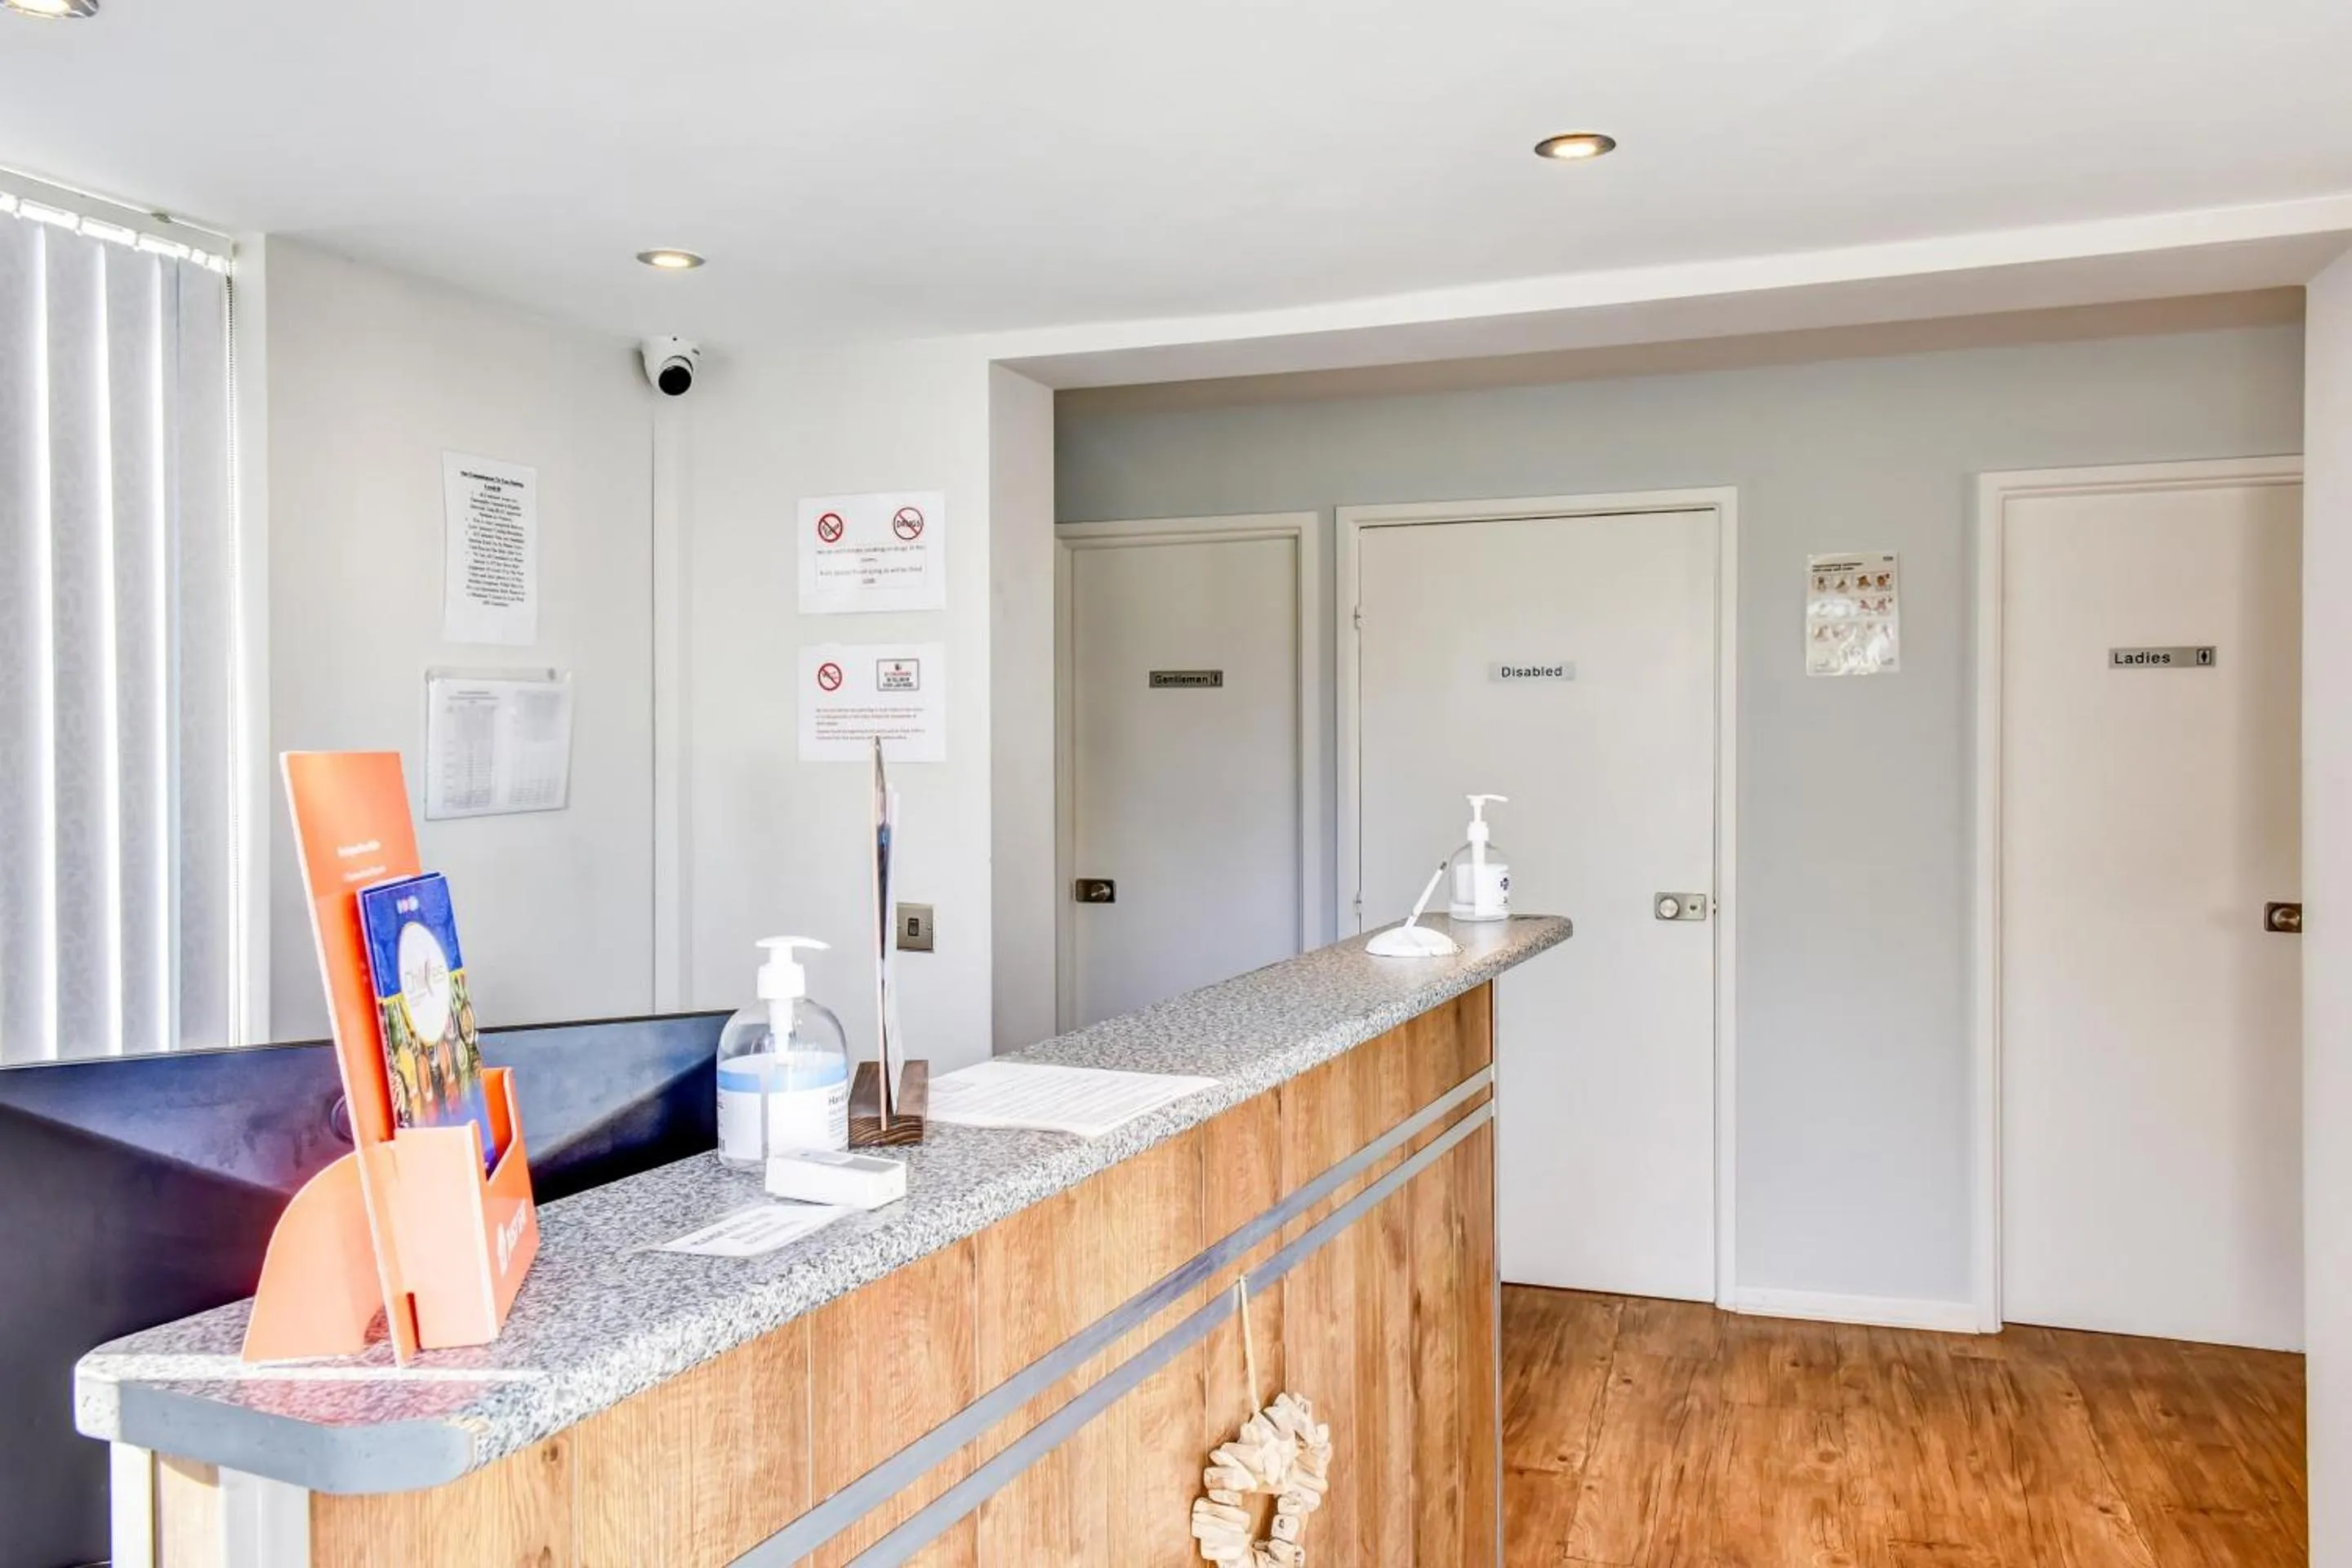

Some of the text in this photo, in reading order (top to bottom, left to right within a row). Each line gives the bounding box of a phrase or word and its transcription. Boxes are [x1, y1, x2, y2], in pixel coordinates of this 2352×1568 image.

[896, 519, 920, 528] DRUGS
[2114, 652, 2171, 664] Ladies
[1501, 666, 1562, 678] Disabled
[1155, 675, 1208, 684] Gentlemen
